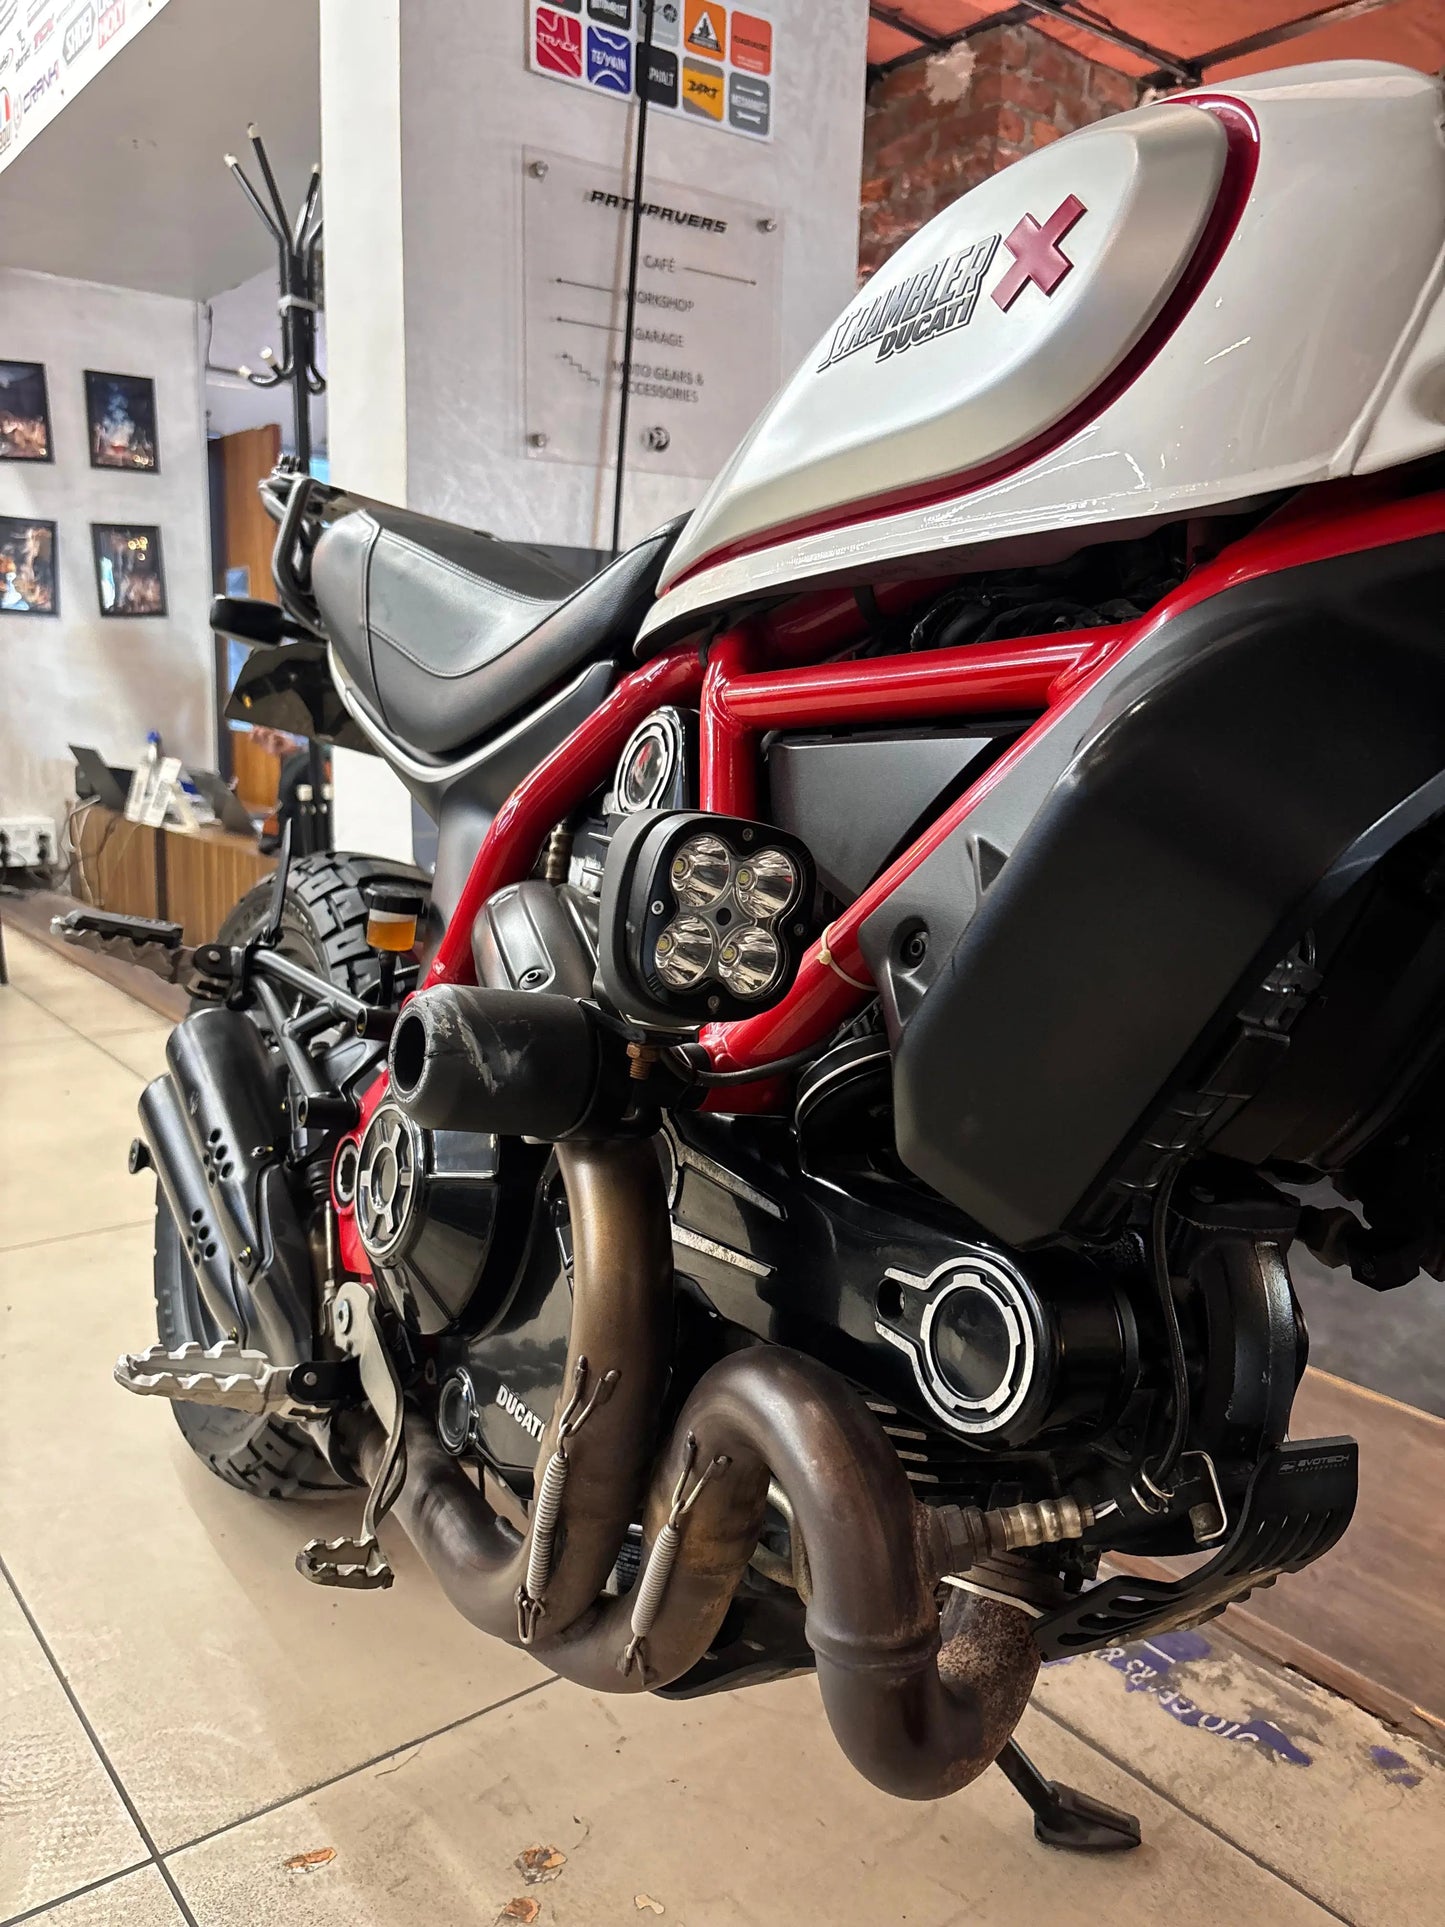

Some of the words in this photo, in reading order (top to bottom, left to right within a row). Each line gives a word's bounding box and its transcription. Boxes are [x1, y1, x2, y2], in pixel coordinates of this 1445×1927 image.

[537, 32, 580, 53] TRACK
[817, 234, 998, 372] SCRAMBLER
[877, 297, 972, 359] DUCATI
[634, 326, 685, 348] GARAGE
[496, 1383, 546, 1443] DUCATI
